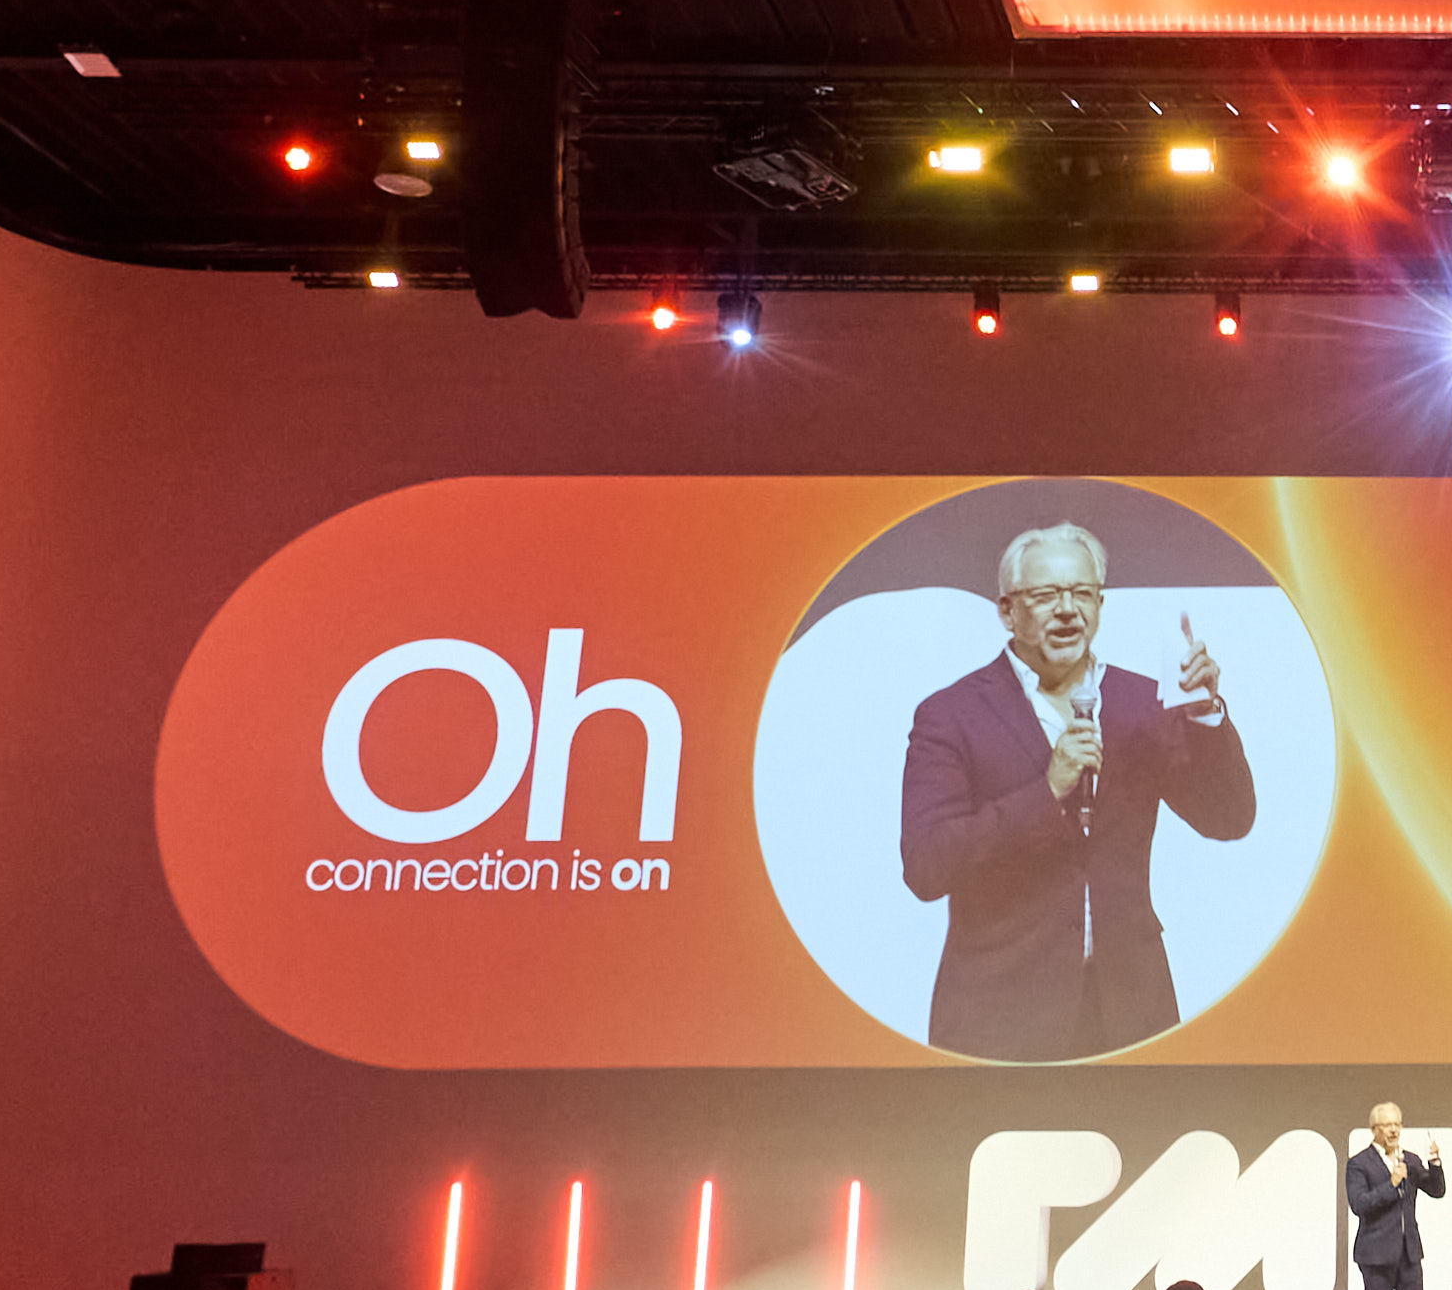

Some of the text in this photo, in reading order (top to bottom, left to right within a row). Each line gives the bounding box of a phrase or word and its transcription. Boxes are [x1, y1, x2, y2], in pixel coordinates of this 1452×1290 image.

[322, 627, 683, 844] Oh
[305, 850, 671, 892] connection is on
